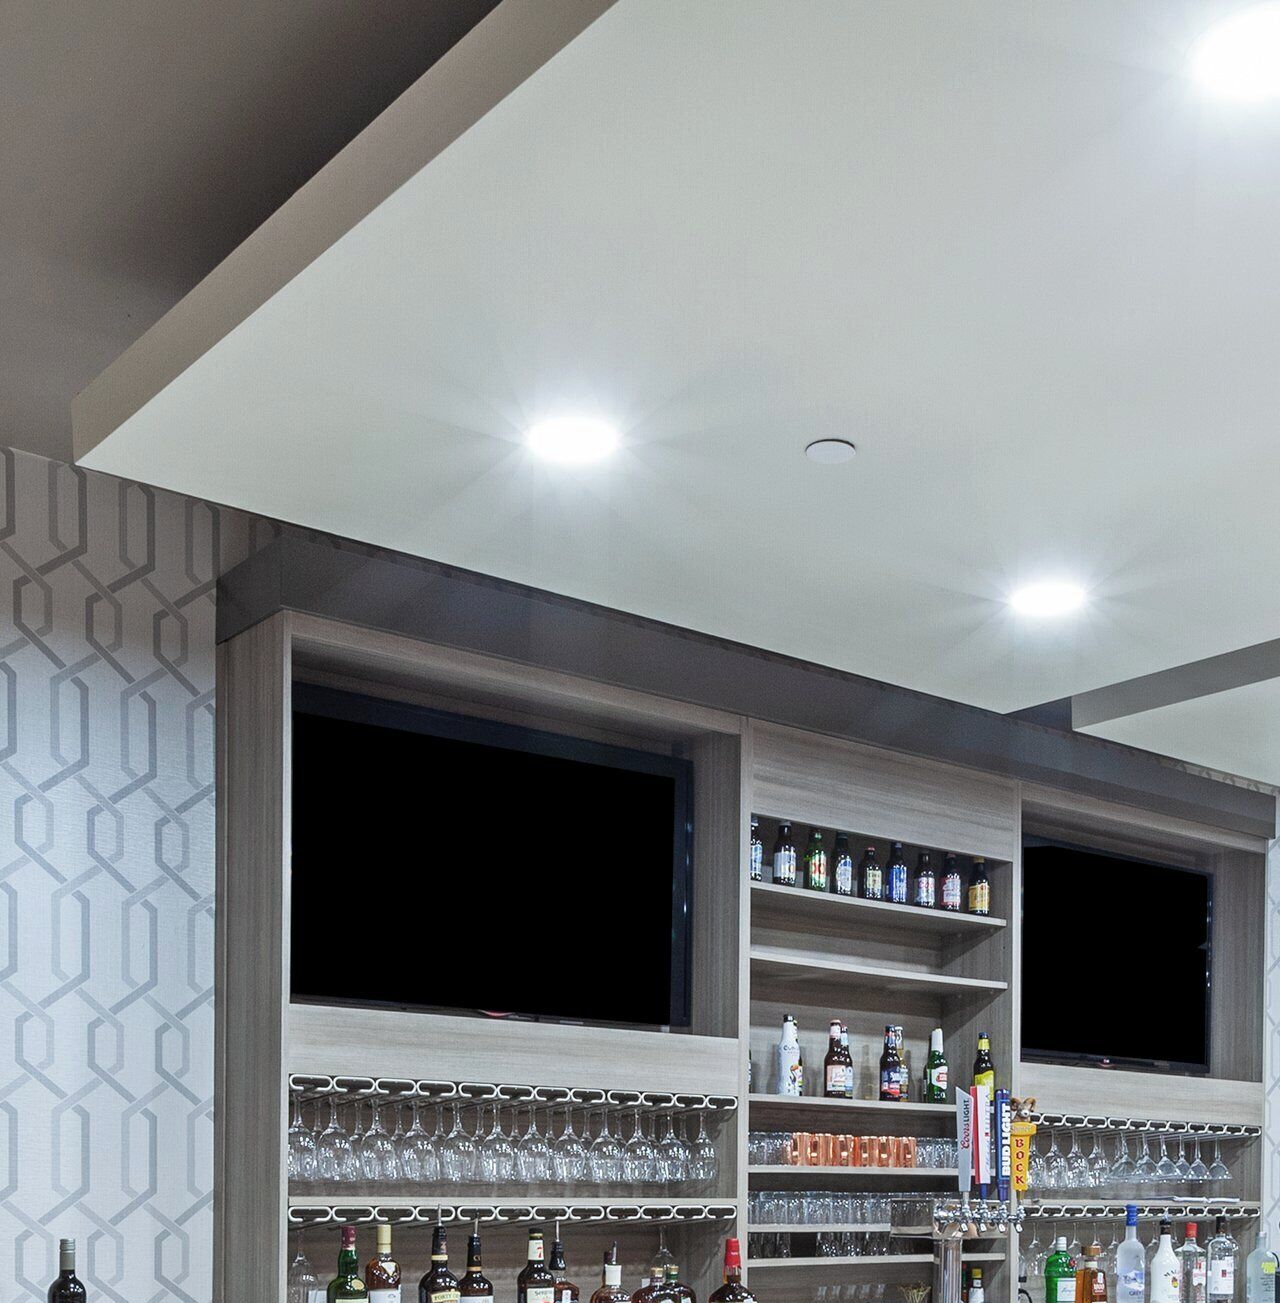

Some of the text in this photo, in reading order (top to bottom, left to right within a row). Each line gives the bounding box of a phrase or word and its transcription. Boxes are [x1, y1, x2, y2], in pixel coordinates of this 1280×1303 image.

[961, 1123, 970, 1150] Coors
[1001, 1102, 1011, 1177] BUD LIGHT
[1015, 1138, 1025, 1185] BOCK
